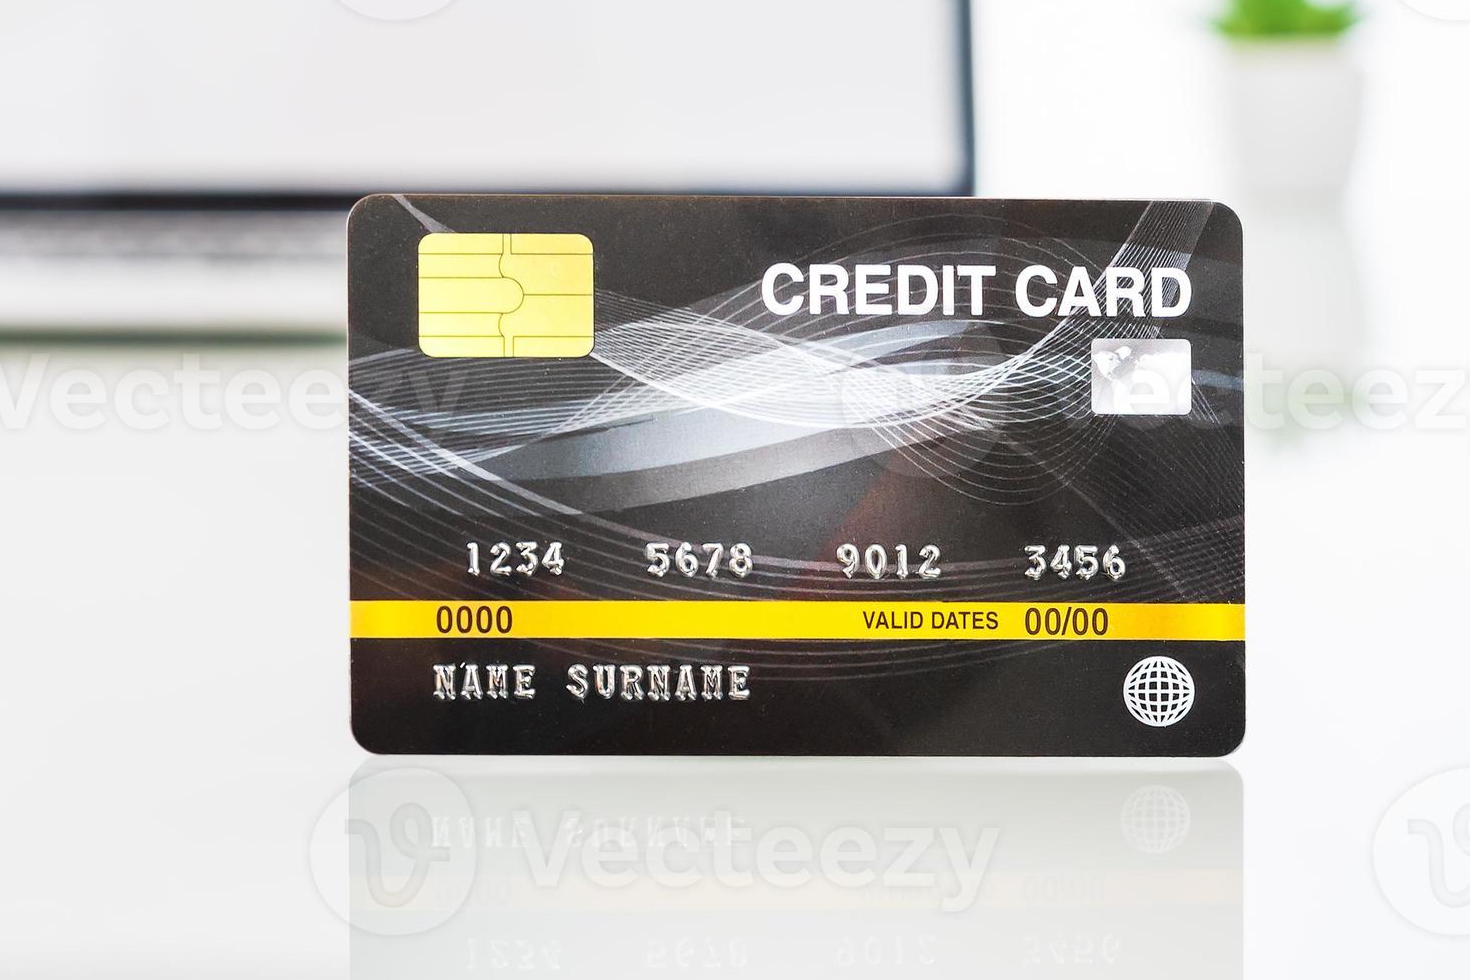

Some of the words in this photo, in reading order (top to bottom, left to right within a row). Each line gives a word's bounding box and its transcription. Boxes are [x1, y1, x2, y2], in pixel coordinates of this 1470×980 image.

[761, 262, 997, 316] CREDIT
[1014, 265, 1192, 318] CARD
[466, 541, 565, 578] 1234
[644, 541, 755, 579] 5678
[835, 543, 943, 581] 9012
[1023, 543, 1127, 582] 3456
[436, 605, 513, 635] 0000
[862, 611, 924, 631] VALID
[931, 611, 999, 631] DATES
[1024, 605, 1109, 637] 00/00
[432, 663, 536, 701] NAME
[565, 663, 752, 702] SURNAME
